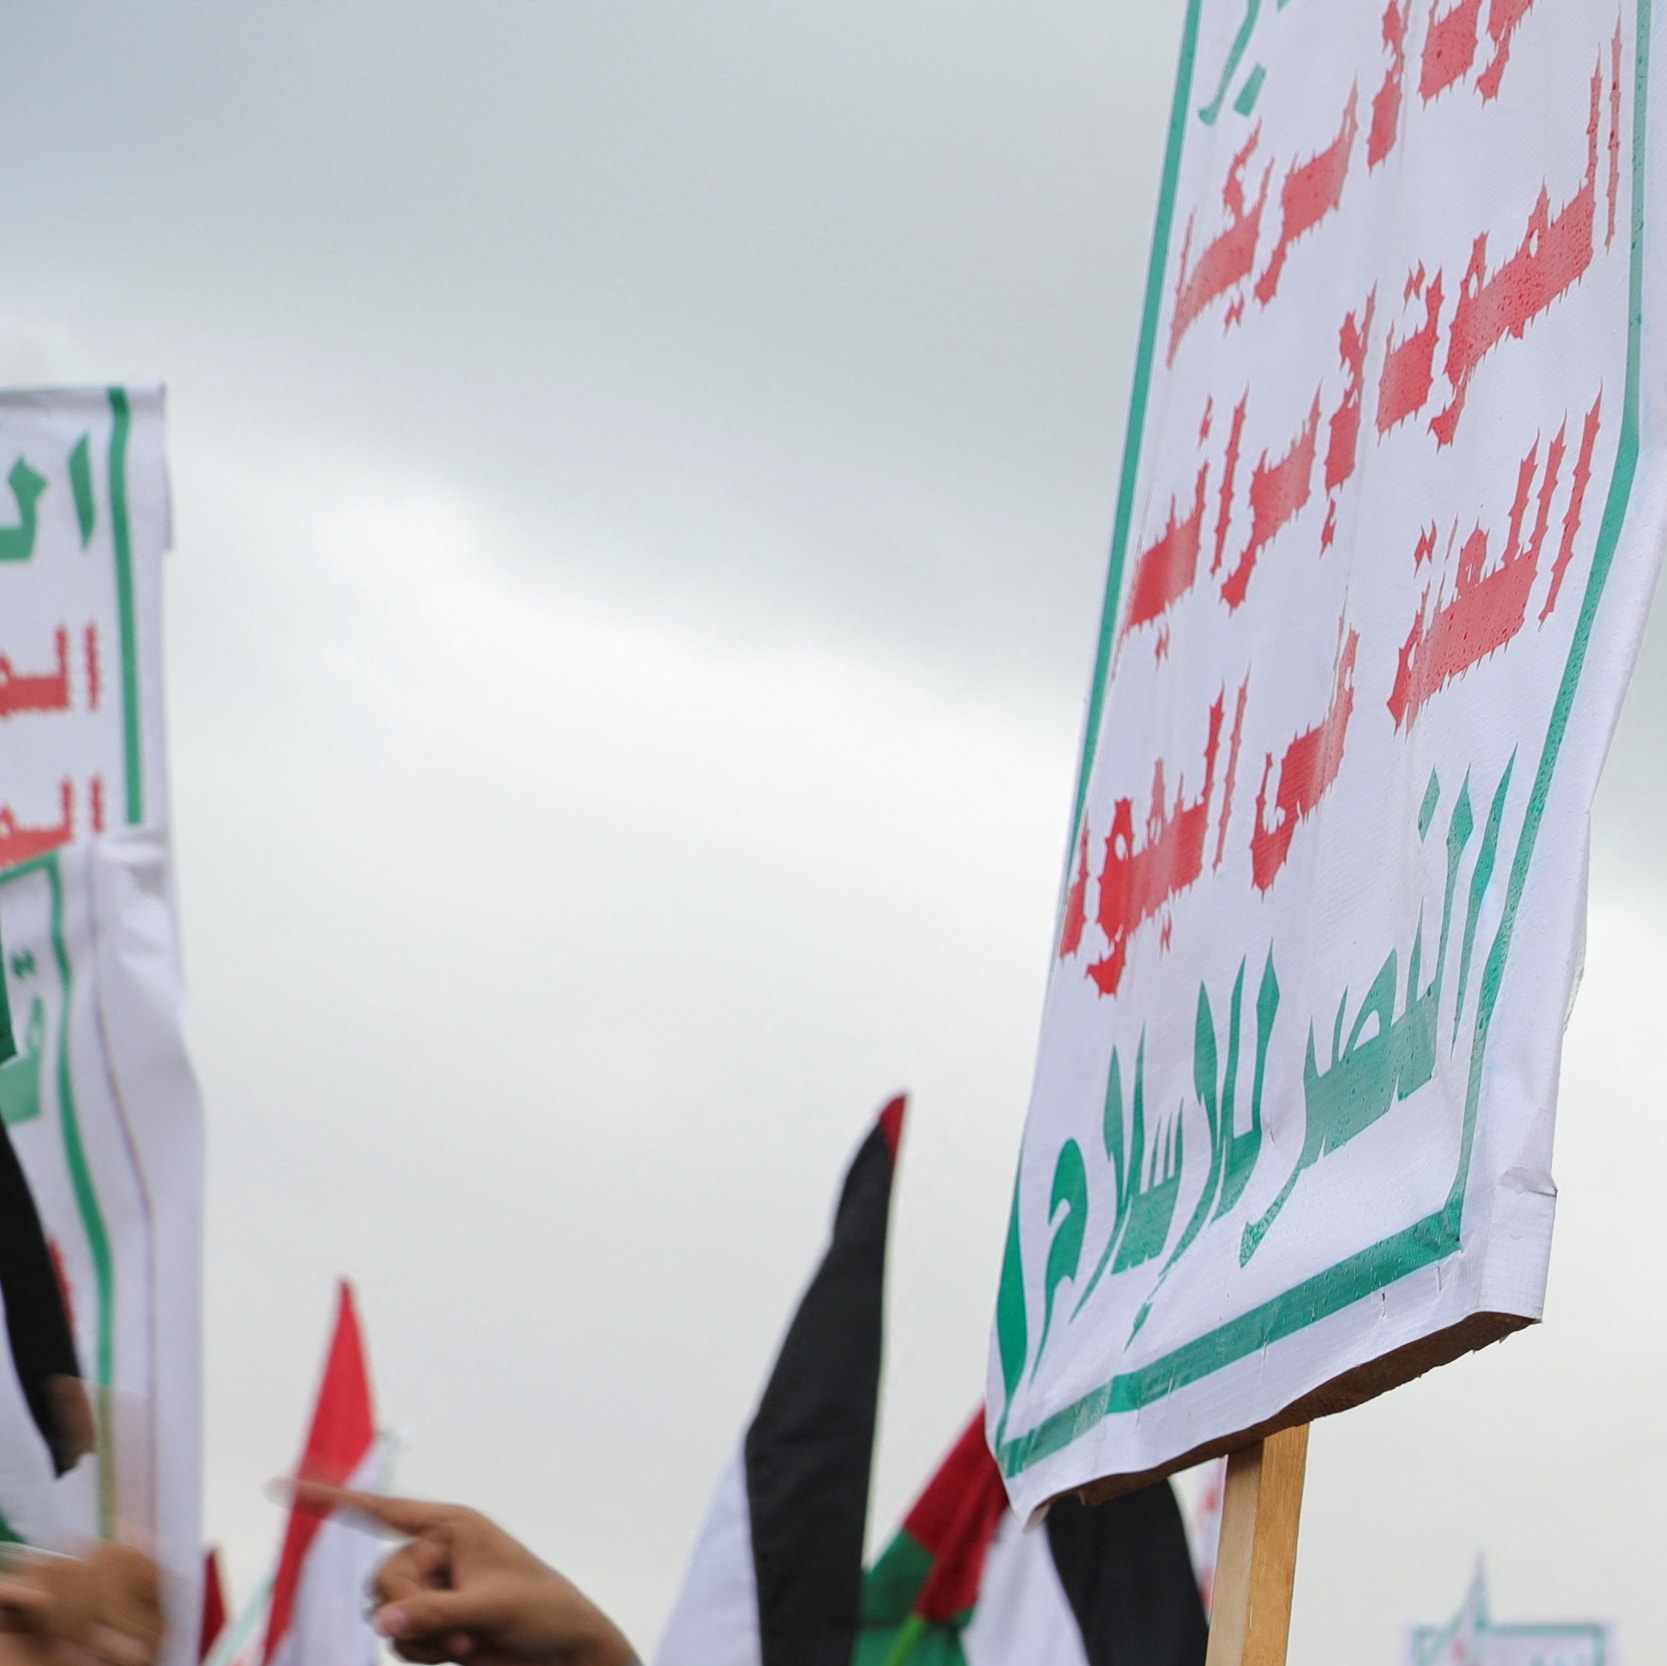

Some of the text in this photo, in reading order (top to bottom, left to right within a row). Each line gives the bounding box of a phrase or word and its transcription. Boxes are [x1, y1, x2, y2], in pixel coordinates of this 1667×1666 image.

[1375, 14, 1622, 452] الموت
[1386, 380, 1602, 735] اللعنة
[1250, 622, 1360, 900] على
[1028, 742, 1518, 1388] النصر للإسلام
